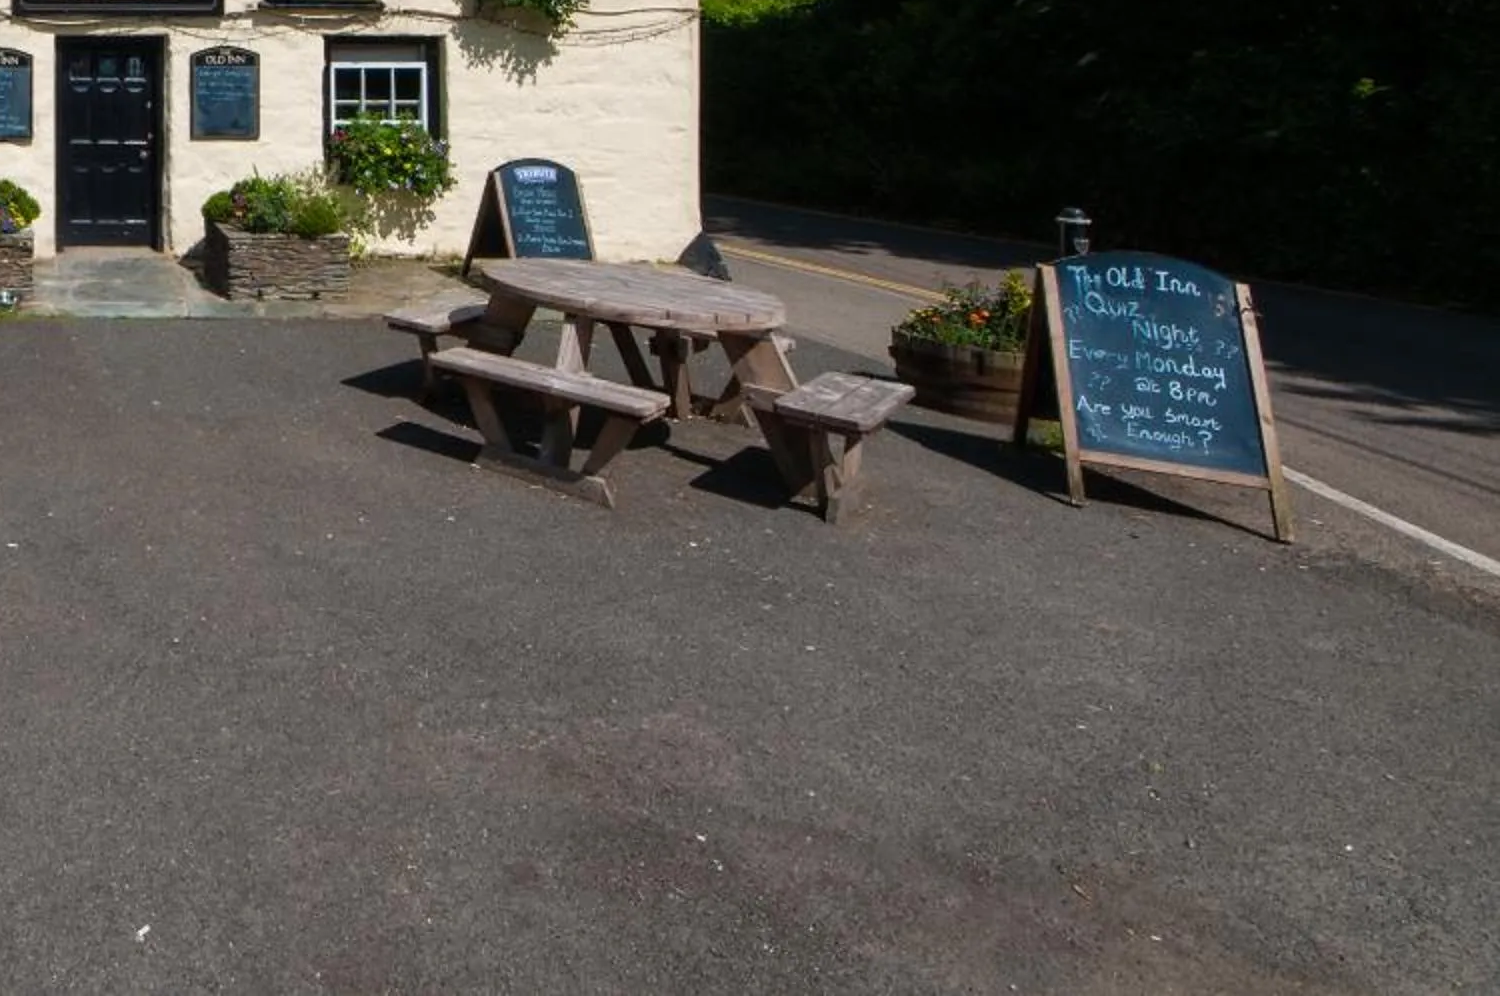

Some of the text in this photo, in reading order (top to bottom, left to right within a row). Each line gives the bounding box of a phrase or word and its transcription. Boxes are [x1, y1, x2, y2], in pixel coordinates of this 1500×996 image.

[1106, 267, 1145, 289] Old
[1156, 271, 1201, 296] Inn
[1136, 352, 1227, 390] Monday
[1077, 395, 1111, 415] Are
[1121, 403, 1155, 422] you
